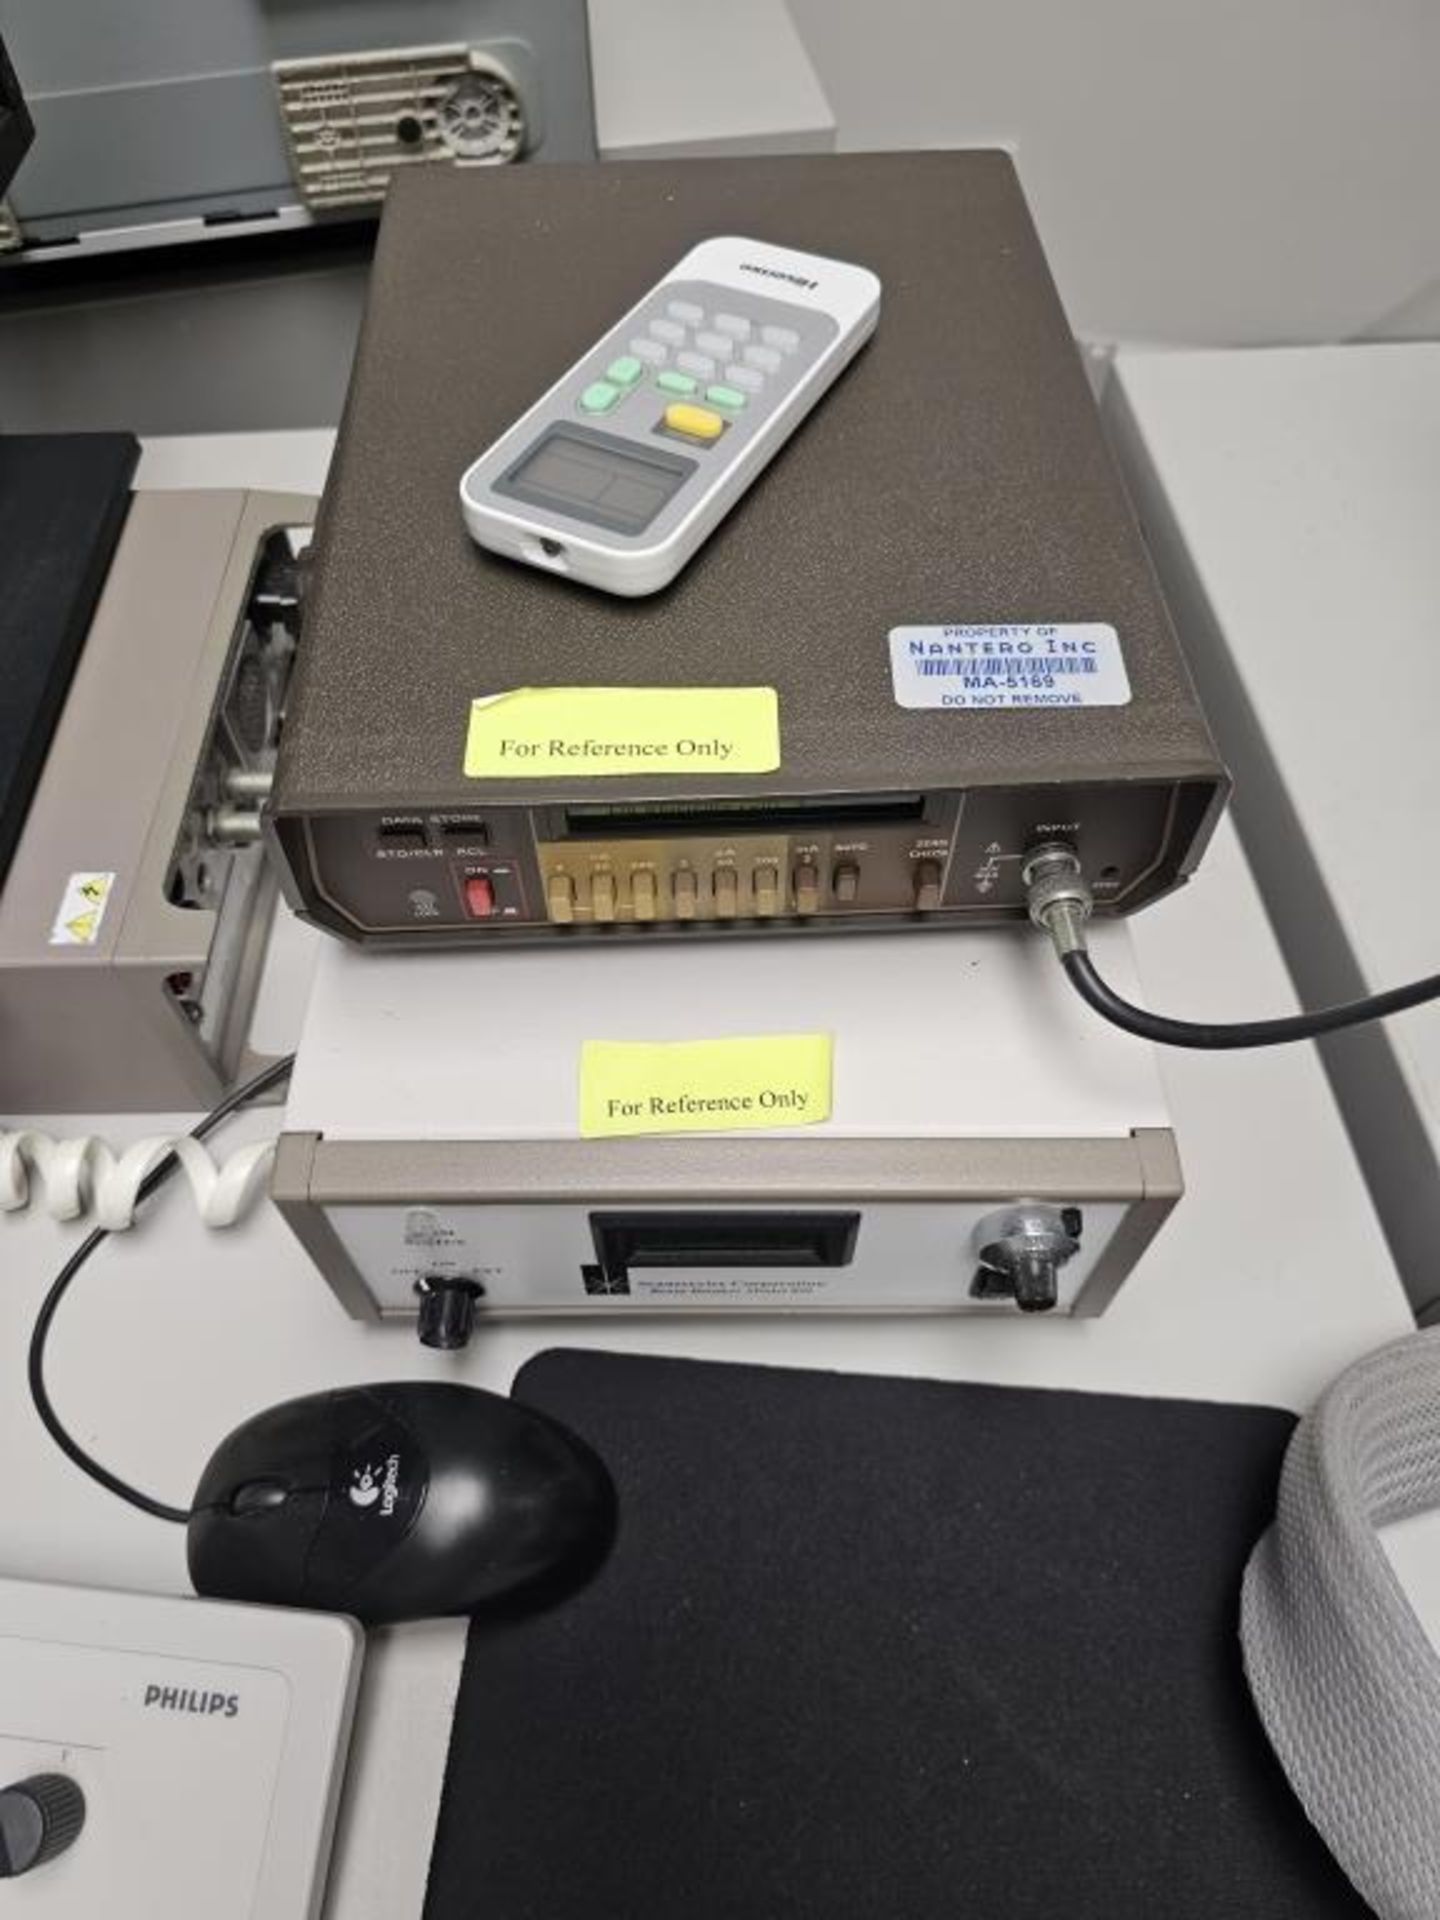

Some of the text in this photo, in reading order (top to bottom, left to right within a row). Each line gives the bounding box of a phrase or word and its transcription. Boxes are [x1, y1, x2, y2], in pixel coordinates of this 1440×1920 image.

[943, 627, 1058, 638] PROPERTY OF
[908, 639, 1097, 655] NANTERO INC
[941, 693, 1083, 706] DO NOT REMOVE
[499, 737, 734, 761] For Reference Only
[607, 1088, 810, 1119] For Reference Only
[380, 1454, 400, 1515] Logitech
[143, 1684, 239, 1719] PHILIPS
